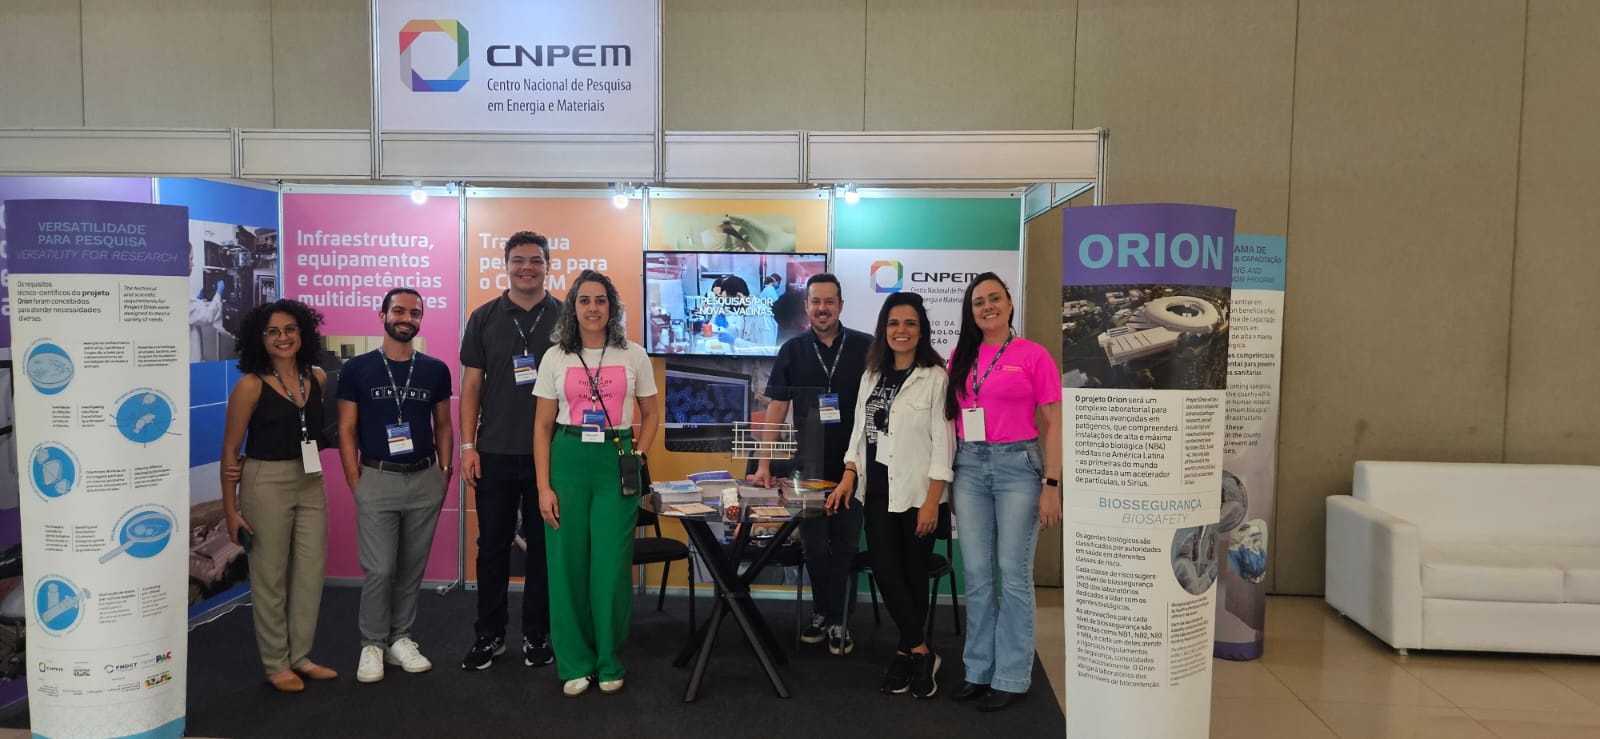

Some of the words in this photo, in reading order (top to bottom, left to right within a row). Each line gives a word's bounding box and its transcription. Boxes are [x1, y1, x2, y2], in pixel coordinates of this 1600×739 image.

[486, 44, 631, 67] CNPEM
[487, 78, 520, 91] Centro
[524, 78, 568, 91] Nacional
[571, 78, 584, 91] de
[586, 78, 631, 94] Pesquisa
[488, 102, 504, 112] em
[507, 99, 546, 114] Energia
[548, 102, 554, 112] e
[557, 99, 604, 112] Materiais
[38, 222, 146, 235] VERSATILIDADE
[38, 234, 71, 245] PARA
[76, 235, 147, 247] PESQUISA
[298, 230, 434, 250] Infraestrutura,
[81, 250, 108, 260] FOR
[112, 251, 178, 262] RESEARCH
[1079, 233, 1224, 270] ORION
[298, 251, 430, 270] equipamentos
[567, 258, 608, 274] para
[298, 274, 308, 286] e
[313, 272, 442, 288] competências
[480, 278, 490, 290] o
[82, 290, 110, 298] projeto
[702, 296, 752, 306] PESQUISAS
[754, 297, 773, 306] POR
[700, 306, 730, 314] NOVAS
[1128, 424, 1178, 432] compreenderá
[1076, 431, 1112, 439] instalações
[1099, 498, 1201, 511] BIOSSEGURANÇA
[1122, 513, 1188, 524] BIOSAFETY
[1108, 536, 1138, 544] biológicos
